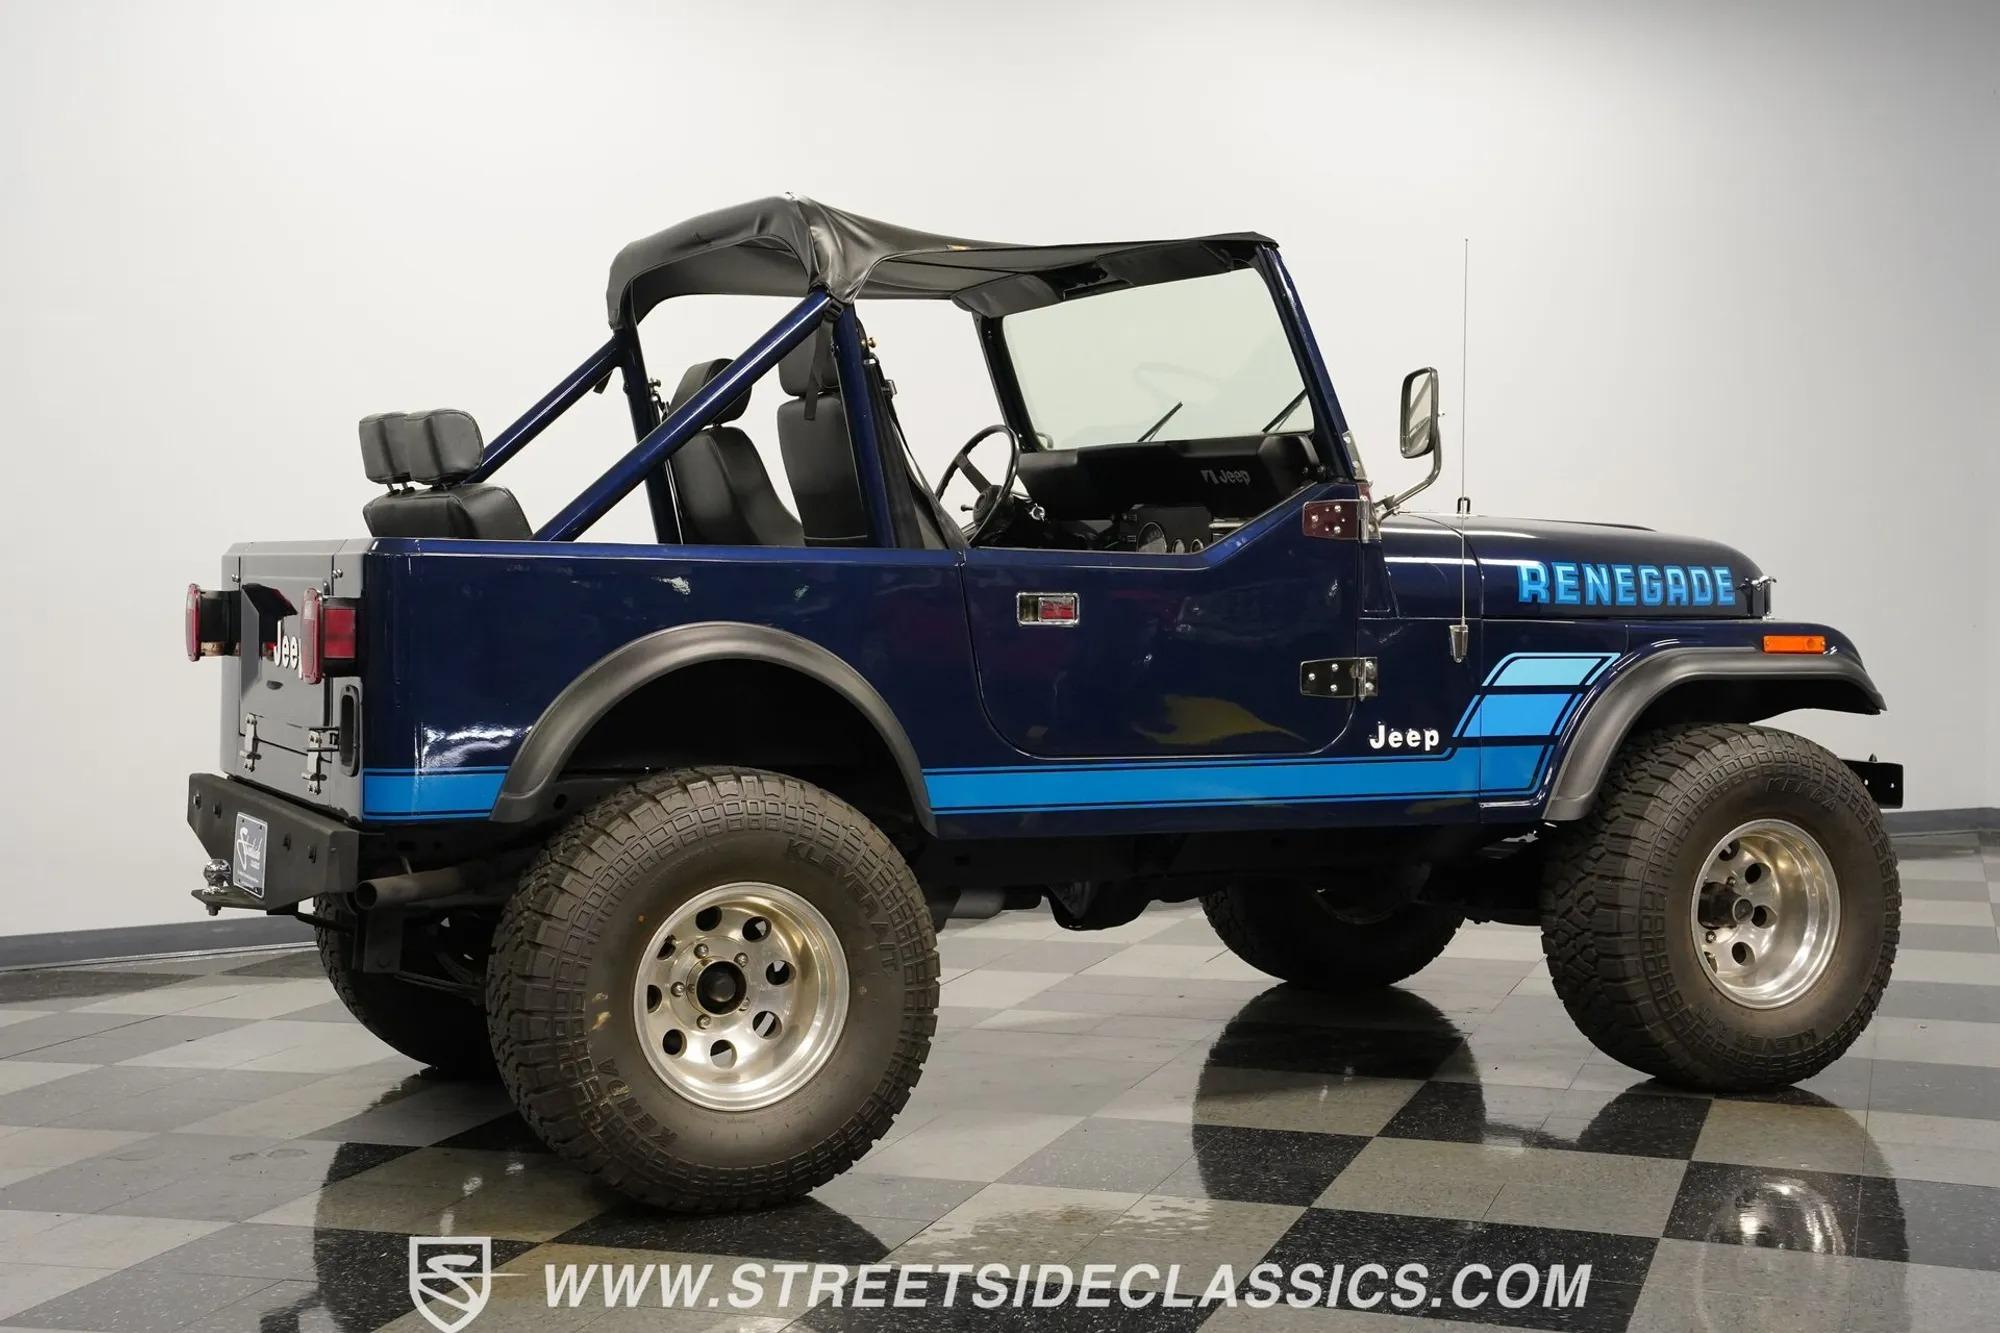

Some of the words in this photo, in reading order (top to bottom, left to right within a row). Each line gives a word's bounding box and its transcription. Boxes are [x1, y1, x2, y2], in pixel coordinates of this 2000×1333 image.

[1219, 469, 1252, 486] Jeep
[1517, 561, 1737, 607] RENEGADE
[273, 620, 303, 679] Jee
[1369, 721, 1440, 753] Jeep
